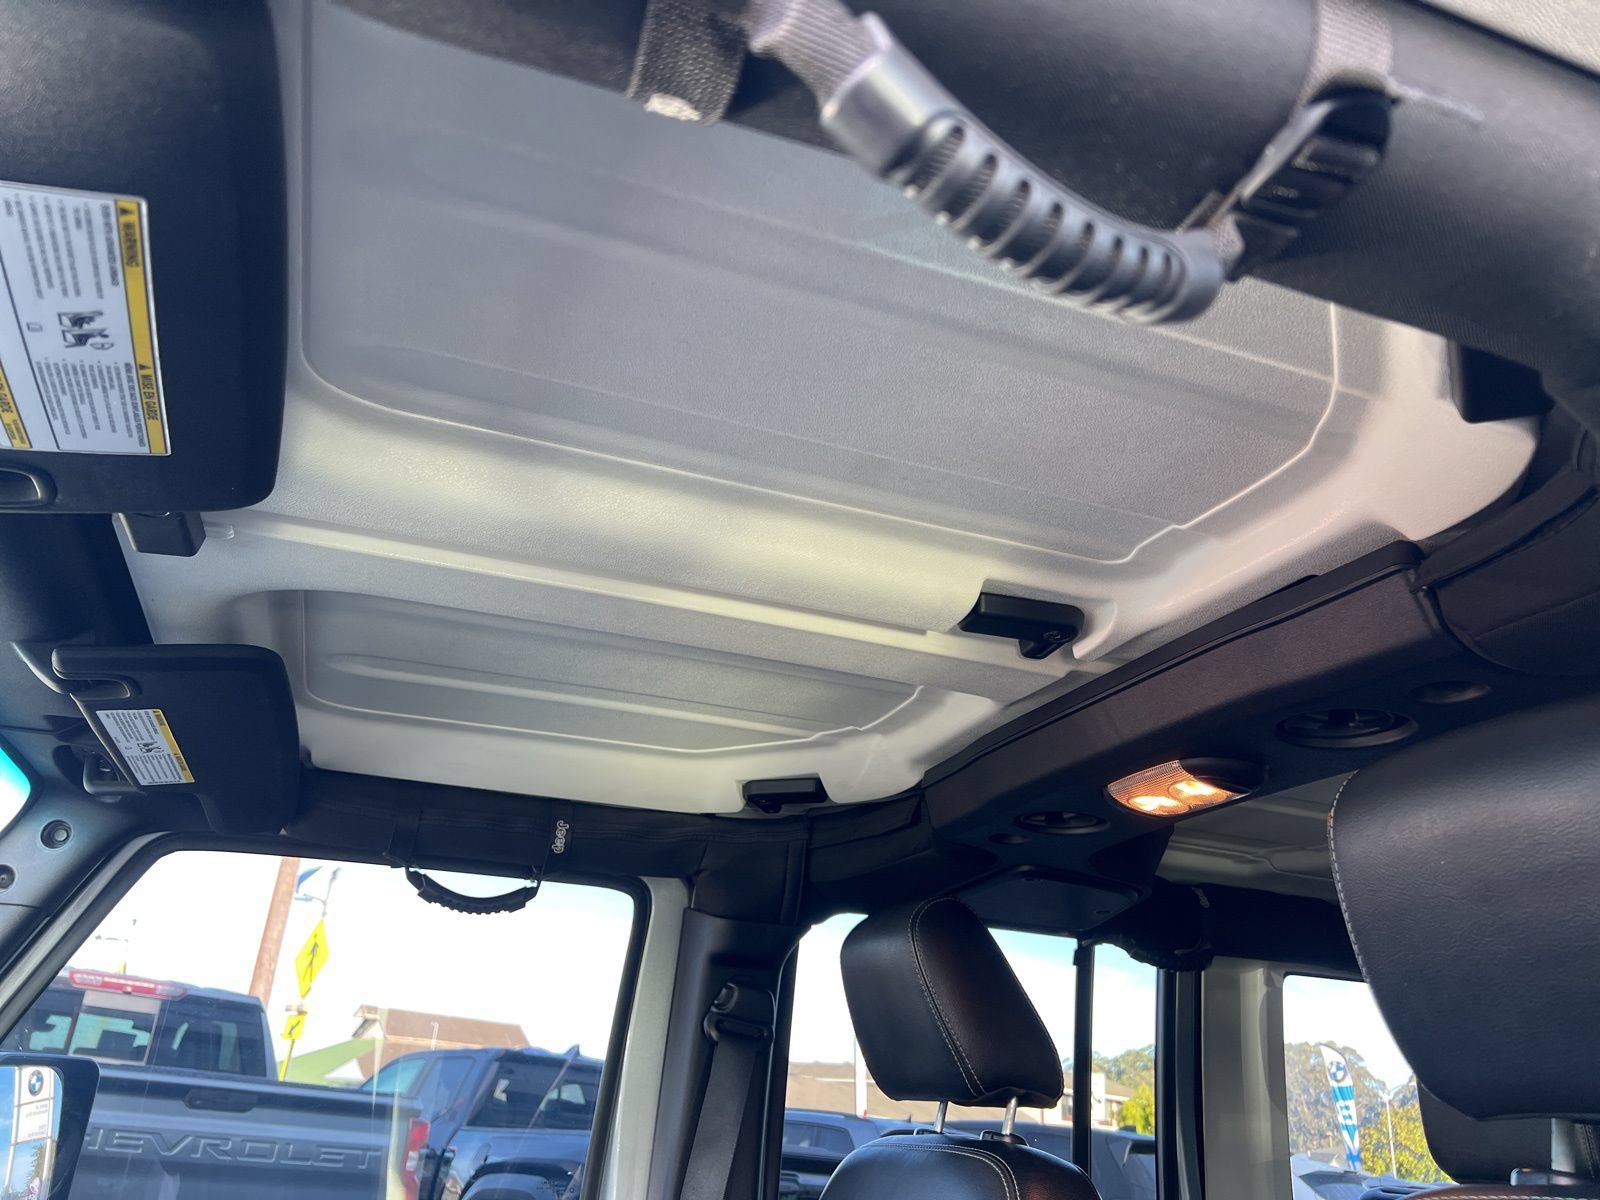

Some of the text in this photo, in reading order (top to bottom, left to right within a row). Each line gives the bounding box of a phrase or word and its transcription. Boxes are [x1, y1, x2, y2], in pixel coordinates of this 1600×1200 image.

[141, 374, 159, 420] MISE EN GARDE
[552, 820, 570, 853] Jeep
[84, 1128, 382, 1170] HEVROLET
